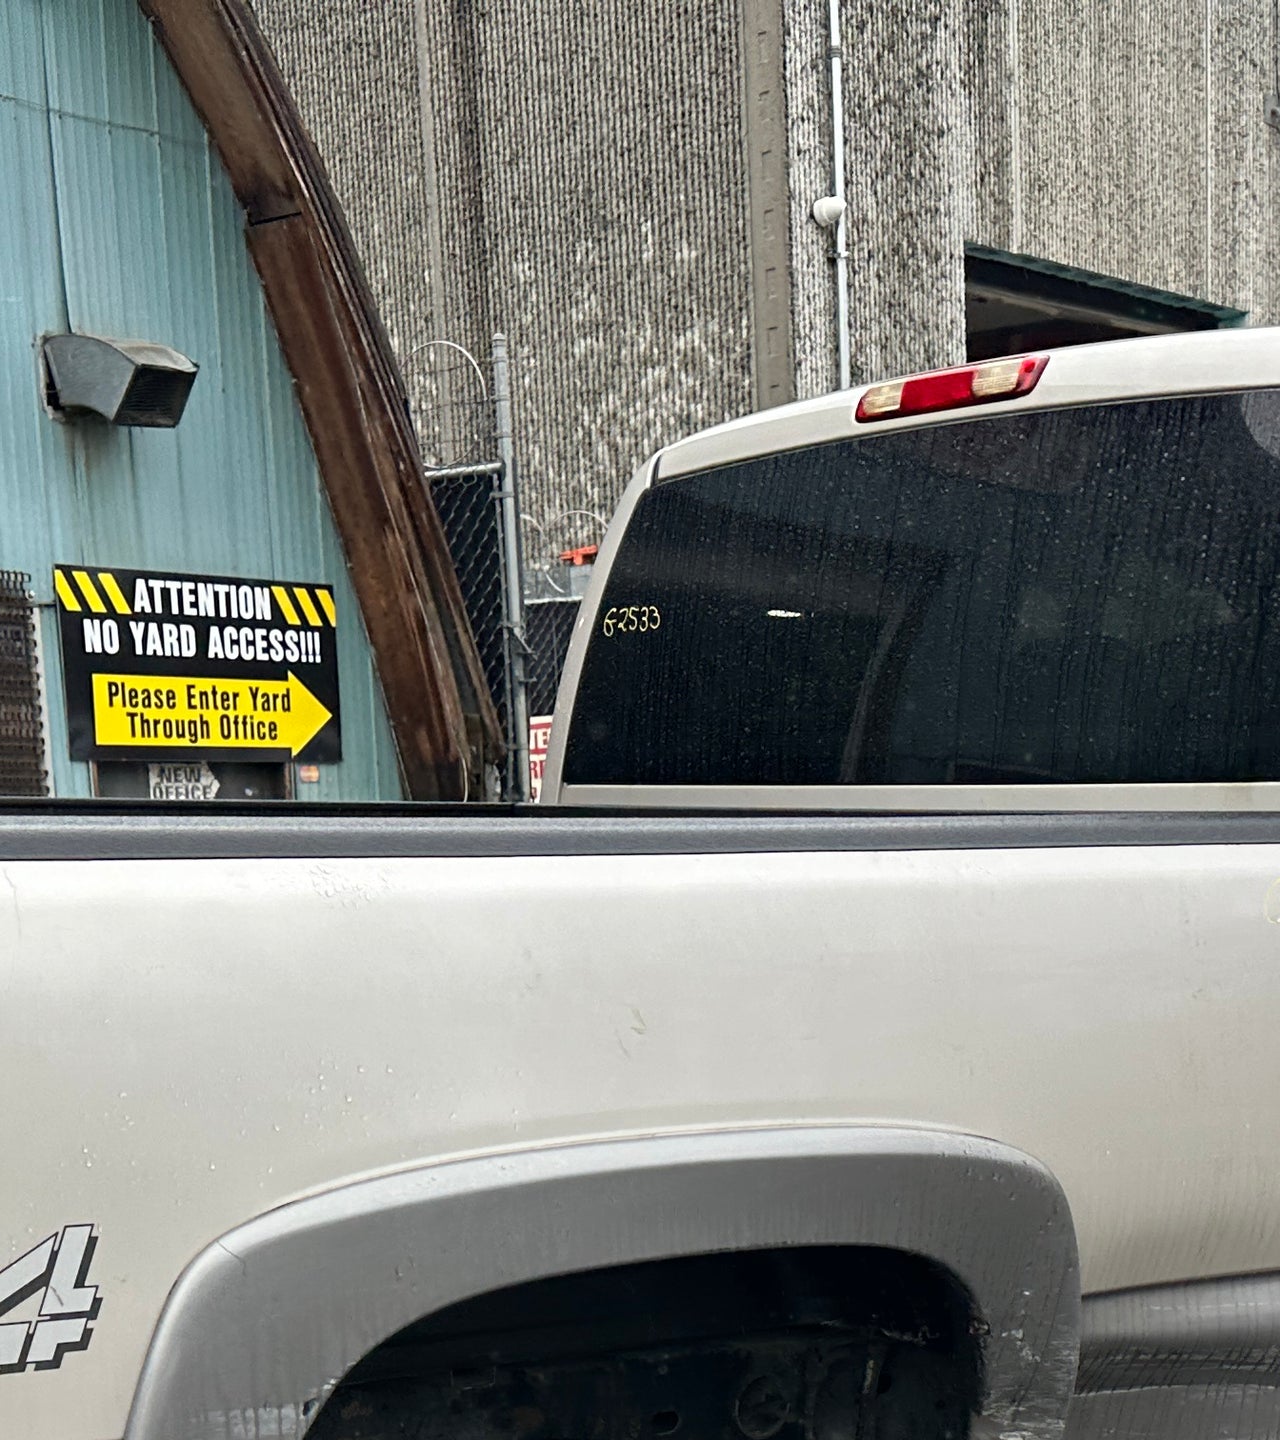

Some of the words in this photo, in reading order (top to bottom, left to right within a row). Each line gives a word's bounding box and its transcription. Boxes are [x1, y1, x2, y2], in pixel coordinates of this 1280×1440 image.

[133, 578, 271, 621] ATTENTION
[603, 606, 661, 637] G2533
[82, 618, 120, 655] NO
[129, 621, 197, 658] YARD
[207, 625, 321, 664] ACCESS!!!
[107, 681, 177, 710] Please
[186, 684, 240, 712] Enter
[248, 686, 291, 713] Yard
[126, 712, 211, 744] Through
[220, 714, 278, 741] Office
[158, 764, 202, 783] NEW
[152, 783, 214, 800] OFFICE
